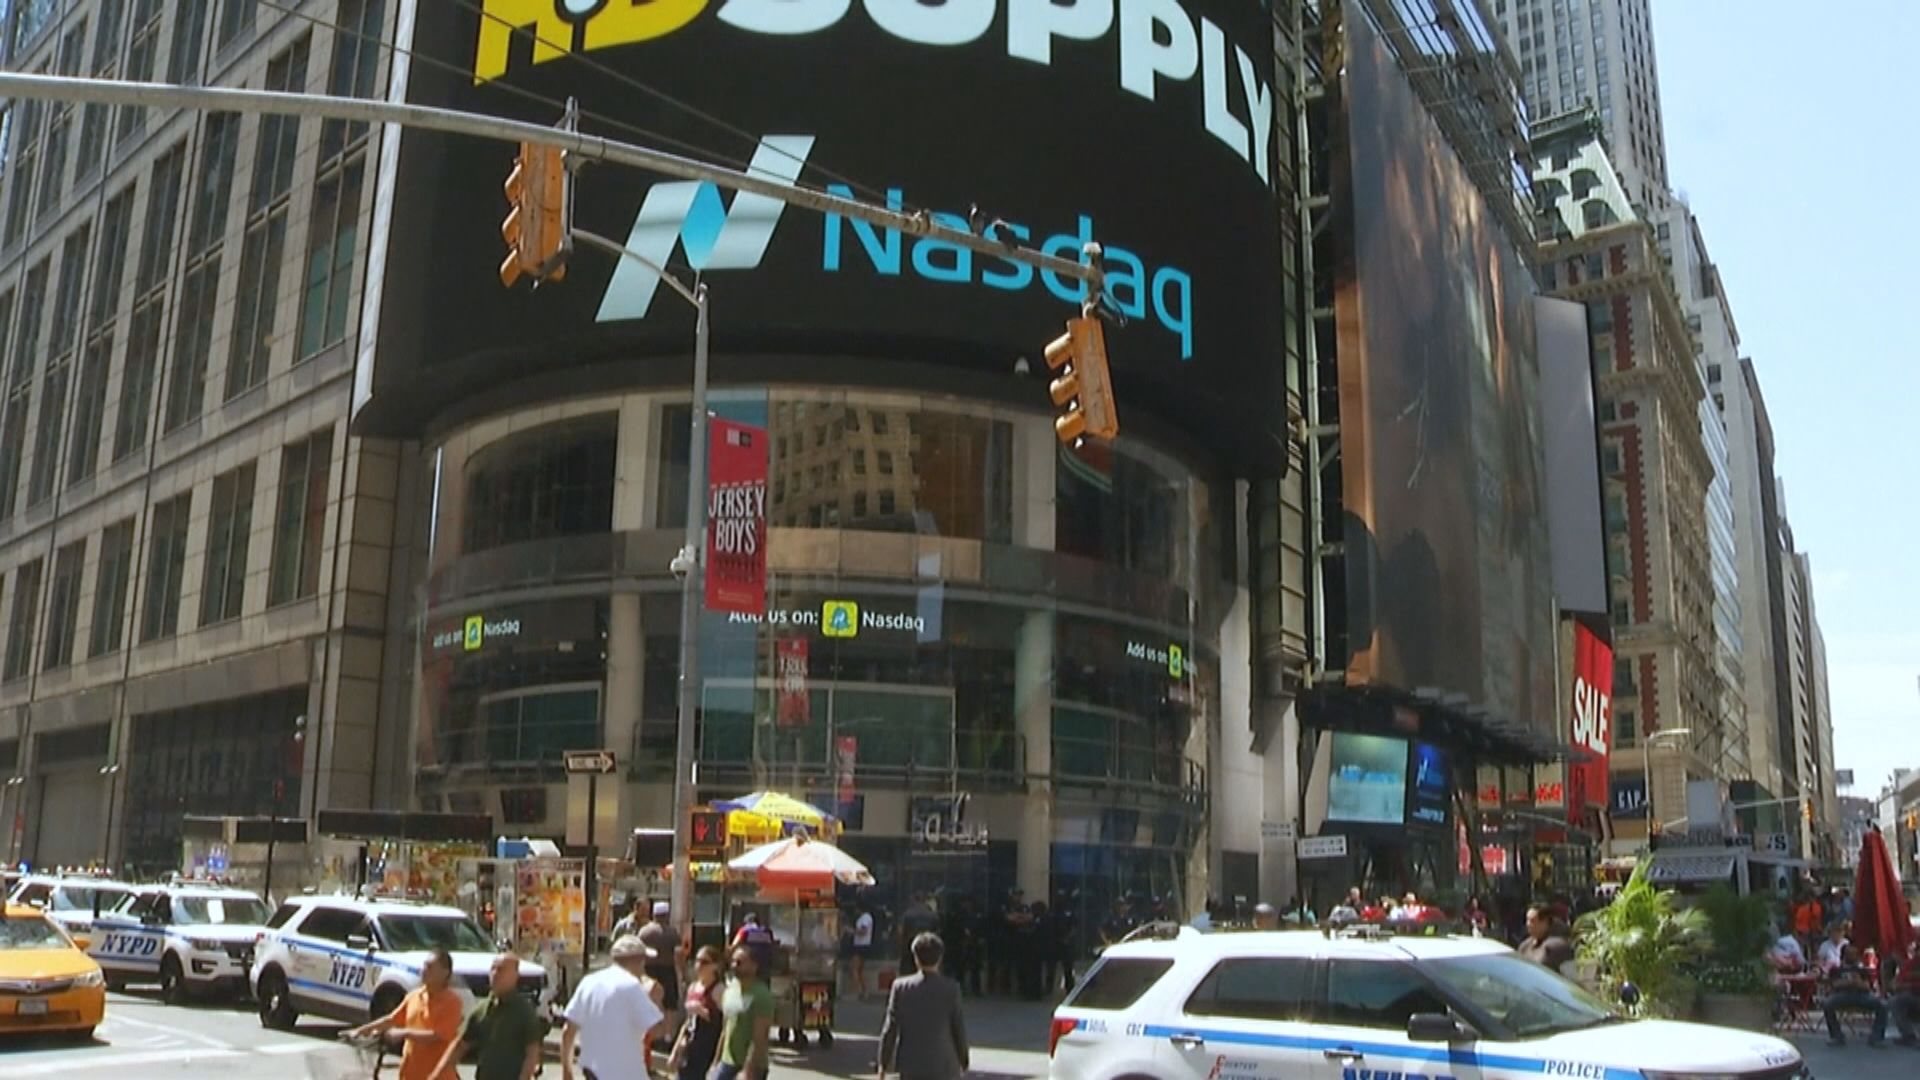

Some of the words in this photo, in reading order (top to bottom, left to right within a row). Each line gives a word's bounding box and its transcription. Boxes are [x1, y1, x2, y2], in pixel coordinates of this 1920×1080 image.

[717, 0, 1272, 185] PPLY
[823, 184, 1191, 359] Nasdaq
[708, 484, 766, 521] JERSEY
[715, 517, 757, 555] BOYS
[767, 610, 788, 624] us
[791, 611, 819, 625] on:
[862, 611, 925, 633] Nasdaq
[1574, 675, 1609, 756] SALE
[1617, 789, 1641, 809] GAP
[100, 933, 158, 957] NYPD
[329, 958, 366, 989] NYPD
[1547, 1060, 1603, 1080] POLICE
